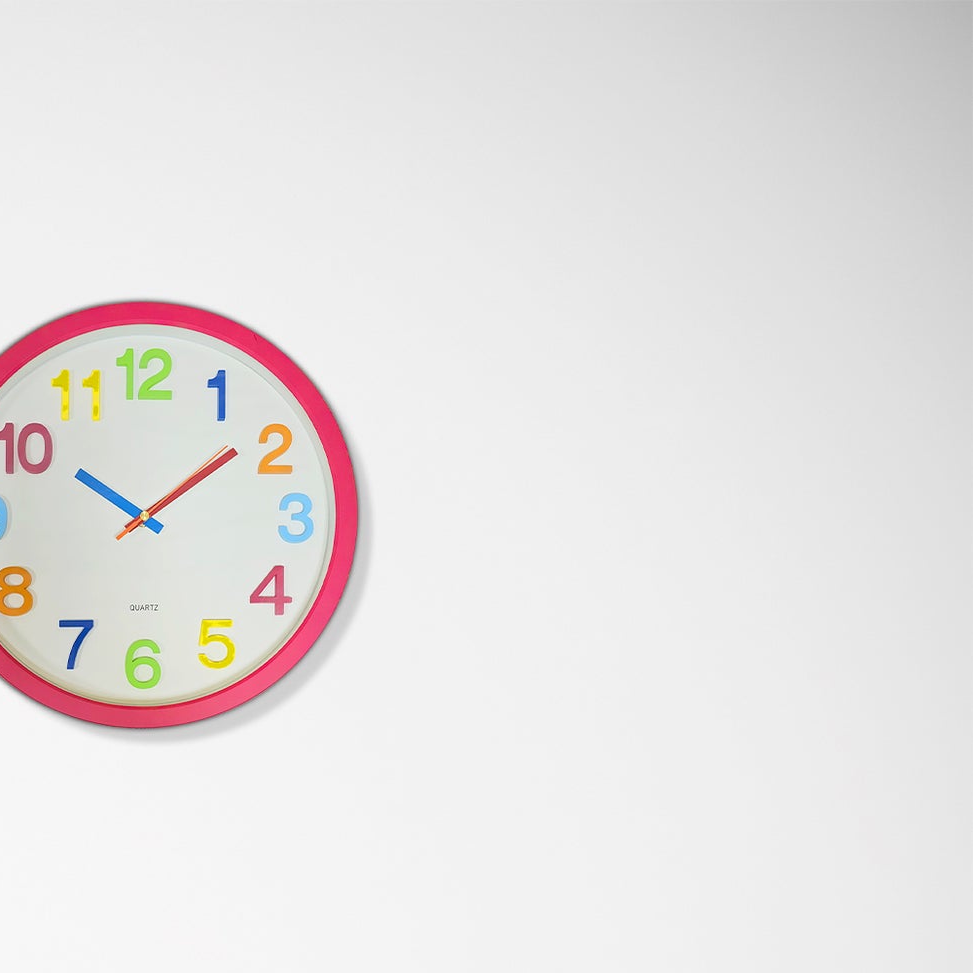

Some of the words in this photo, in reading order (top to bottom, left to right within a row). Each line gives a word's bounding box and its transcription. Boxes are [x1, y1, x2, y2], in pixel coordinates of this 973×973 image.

[51, 369, 101, 421] 11
[116, 348, 172, 400] 12
[207, 370, 226, 421] 1
[257, 424, 293, 474] 2
[277, 493, 314, 543] 3
[249, 565, 292, 615] 4
[59, 619, 94, 669] 7
[125, 639, 161, 689] 6
[197, 618, 236, 669] 5
